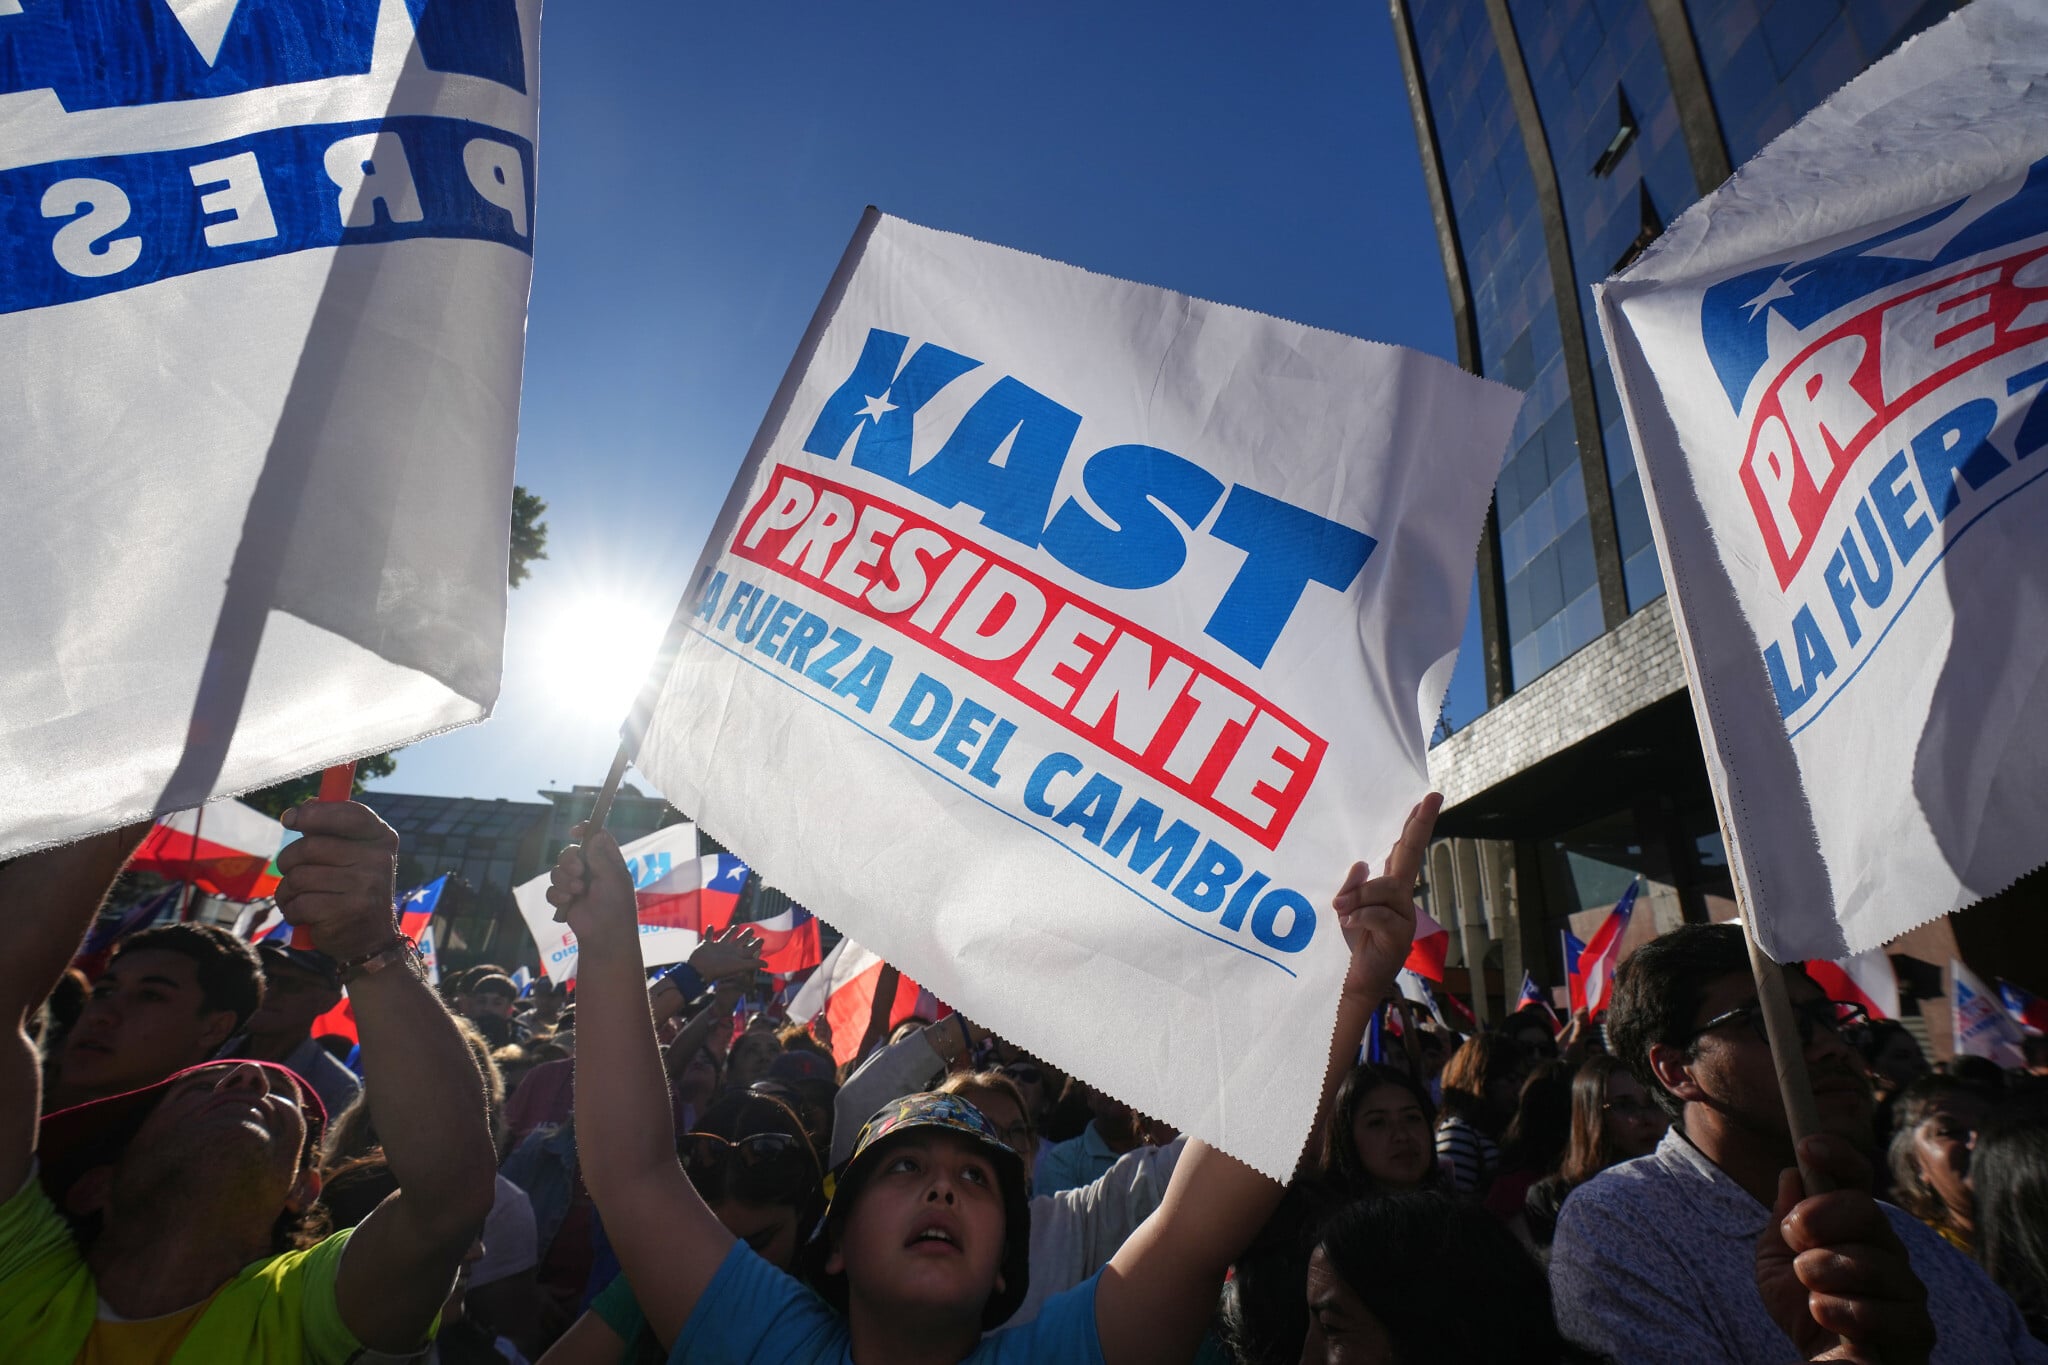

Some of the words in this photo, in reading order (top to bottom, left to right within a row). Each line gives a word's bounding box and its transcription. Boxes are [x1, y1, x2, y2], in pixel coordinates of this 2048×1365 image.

[744, 476, 1312, 831] PRESIDENTE
[802, 327, 1379, 670] KAST
[1764, 602, 1838, 721] LA
[717, 580, 894, 714] FUERZA
[888, 673, 1019, 788] DEL
[1023, 752, 1317, 954] CAMBIO
